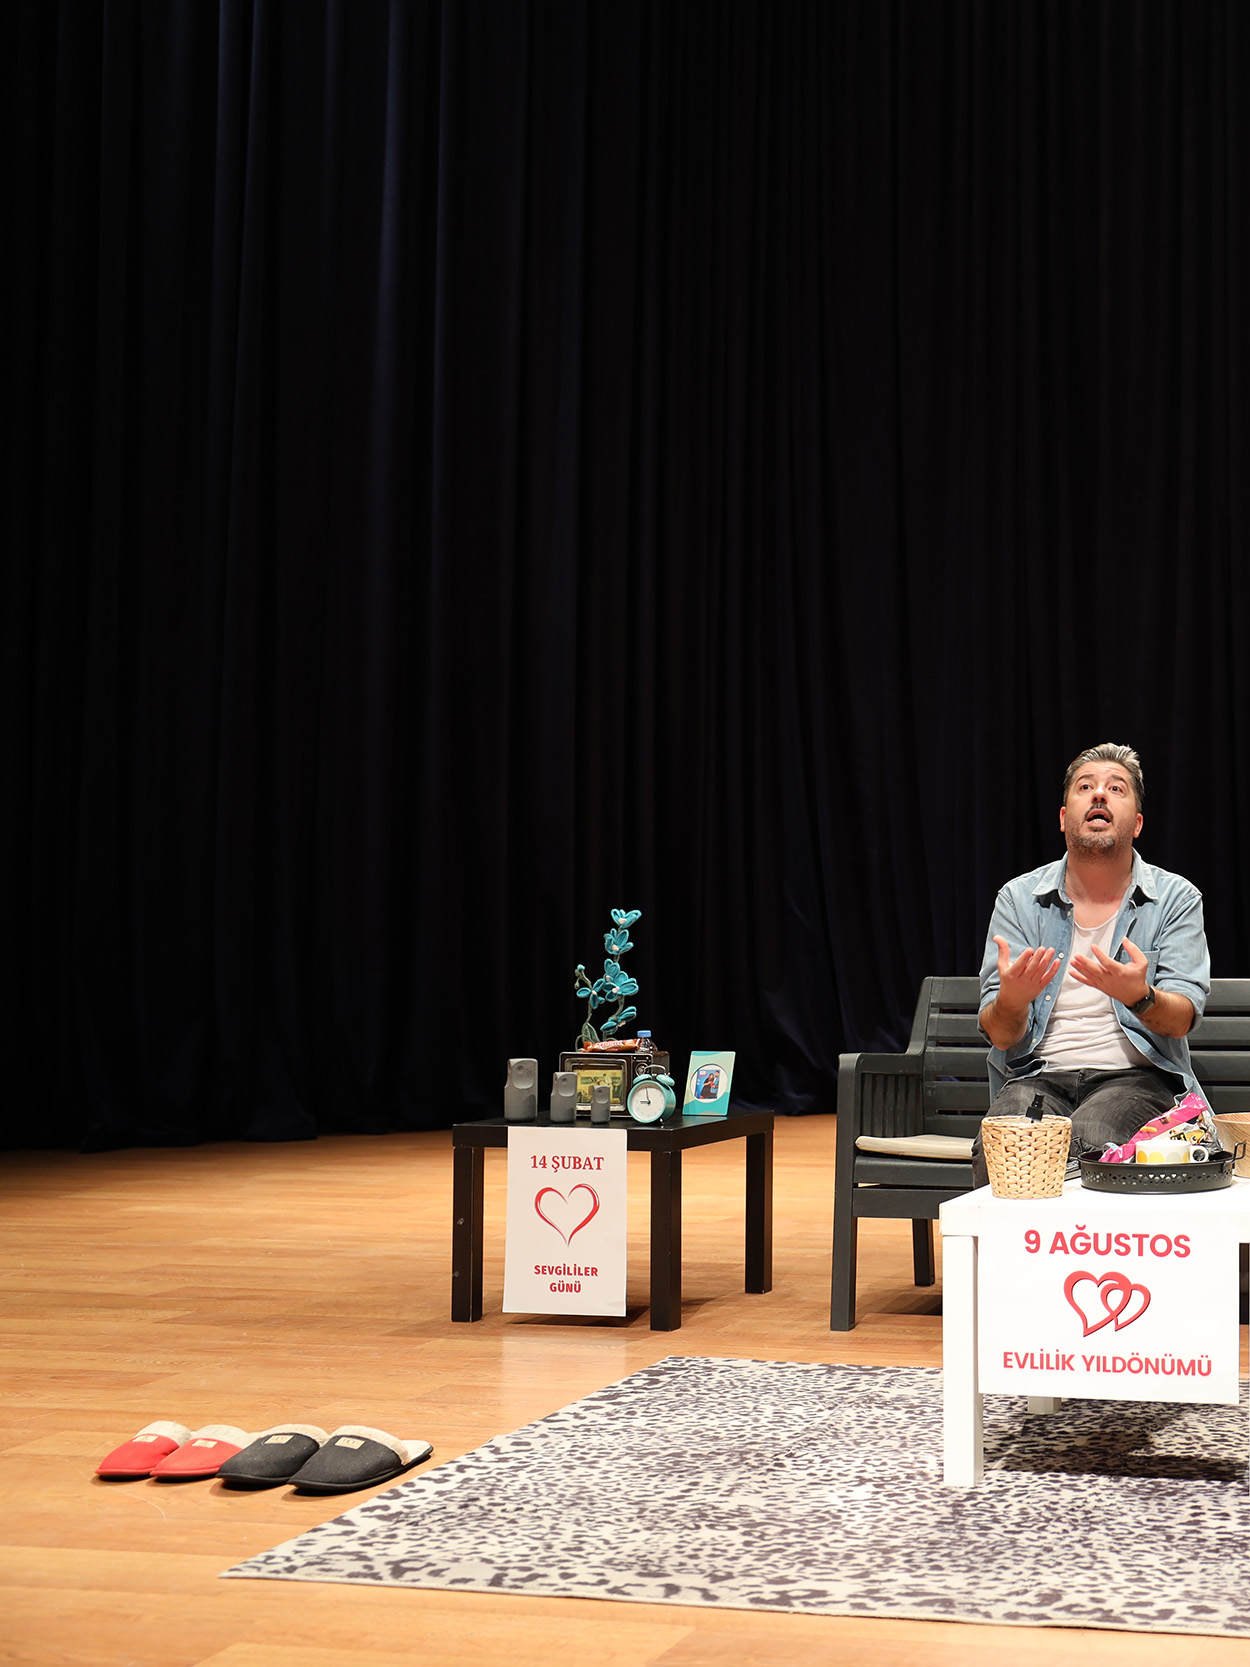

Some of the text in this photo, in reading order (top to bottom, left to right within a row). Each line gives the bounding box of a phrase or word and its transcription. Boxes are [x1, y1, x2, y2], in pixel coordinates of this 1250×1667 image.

[531, 1155, 604, 1172] 14 ŞUBAT
[1025, 1224, 1191, 1258] 9 AĞUSTOS
[534, 1263, 598, 1277] SEVGİLİLER
[550, 1280, 581, 1294] GÜNÜ
[1003, 1348, 1212, 1377] EVLİLİK YILDÖNÜMÜ
